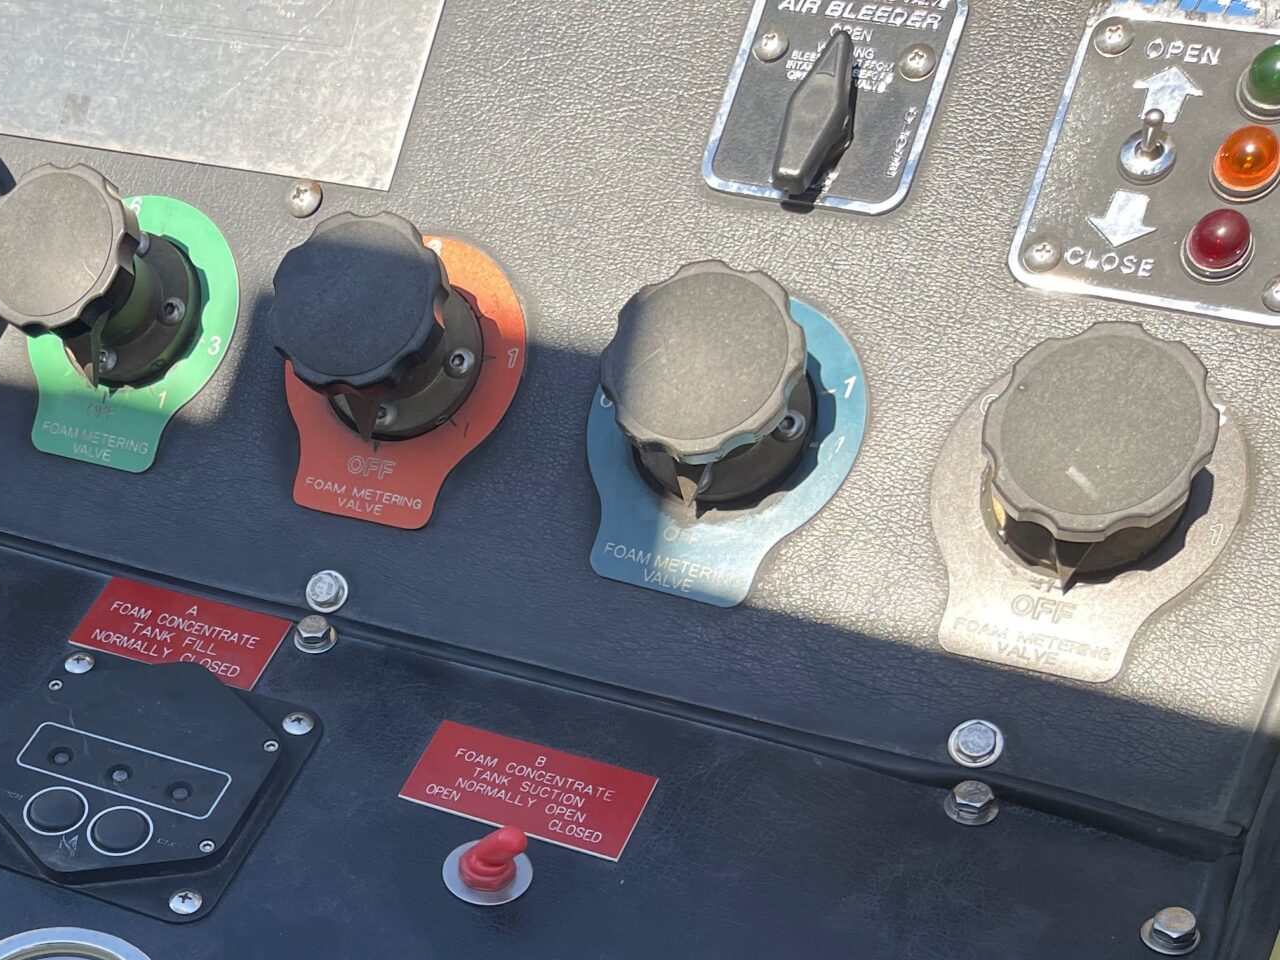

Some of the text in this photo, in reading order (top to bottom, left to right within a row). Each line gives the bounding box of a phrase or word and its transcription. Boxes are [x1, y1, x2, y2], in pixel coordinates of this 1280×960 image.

[777, 0, 943, 30] AIR BLEEDER
[1145, 38, 1222, 66] OPEN
[1063, 247, 1155, 277] CLOSE
[41, 421, 149, 454] FOAM METERING
[73, 442, 112, 462] VALVE
[347, 456, 396, 480] OFF
[305, 477, 423, 510] FOAM METERING
[338, 497, 383, 516] VALVE
[605, 543, 742, 587] FOAM METERING
[643, 568, 694, 592] VALVE
[186, 605, 198, 617] A
[1011, 594, 1077, 624] OFF
[110, 601, 260, 649] FOAM CONCENTRATE
[132, 622, 216, 656] TANK FILL
[953, 616, 1111, 661] FOAM METERING
[91, 628, 174, 658] NORMALLY
[997, 641, 1058, 666] VALVE
[455, 748, 616, 802] FOAM CONCENTRATE
[535, 755, 547, 767] B
[455, 777, 586, 824] NORMALLY OPEN
[473, 767, 585, 808] TANK SUCTION
[425, 783, 603, 844] OPEN CLOSED
